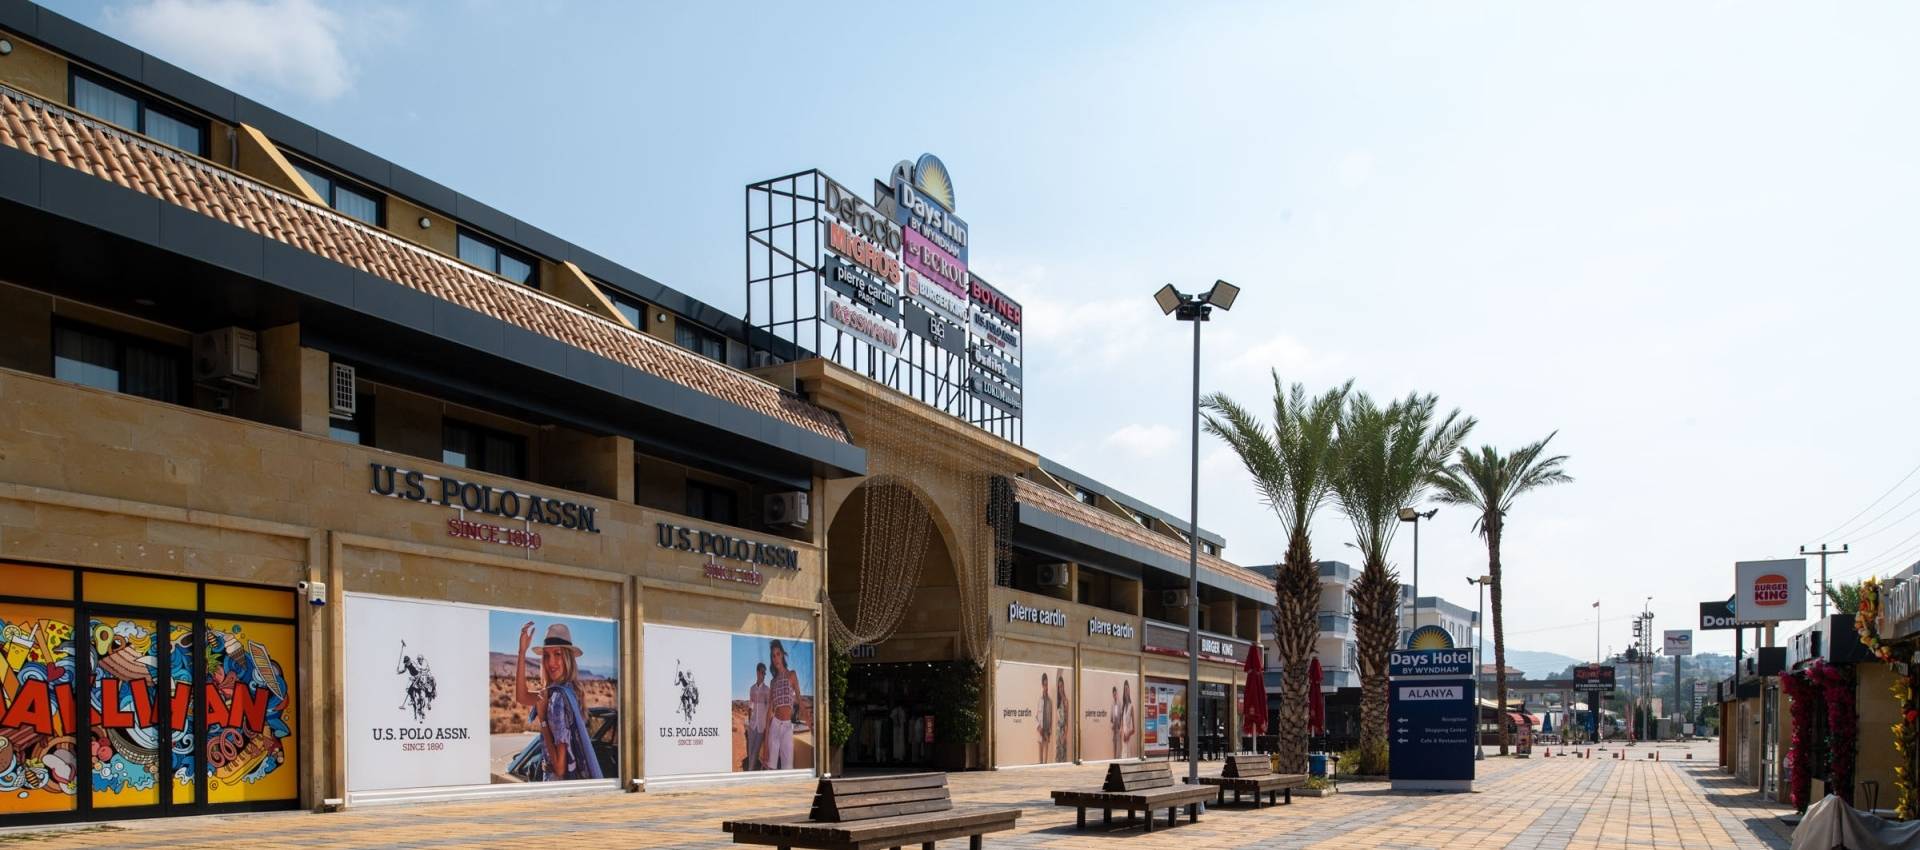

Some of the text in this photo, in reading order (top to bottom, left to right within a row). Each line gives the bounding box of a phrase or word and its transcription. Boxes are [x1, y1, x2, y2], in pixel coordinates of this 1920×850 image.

[903, 183, 967, 246] Days Inn
[911, 217, 922, 233] BY
[922, 224, 960, 258] WYNDHAM
[838, 266, 895, 307] pierre cardin
[858, 290, 876, 306] PARIS
[971, 280, 1020, 325] BOYNER
[831, 300, 898, 349] ROSSMANN
[369, 463, 600, 533] U.S. POLO ASSN.
[447, 518, 500, 543] SINCE
[656, 522, 802, 572] U.S. POLO ASSN.
[1754, 583, 1788, 600] BURGER KING
[1009, 601, 1067, 628] pierre cardin
[1089, 617, 1134, 639] pierre cardin
[1201, 638, 1233, 657] BURGER KING
[1390, 652, 1472, 667] Days Hotel
[1415, 666, 1459, 674] WYNDHAM
[1408, 689, 1454, 698] ALANYA
[1003, 707, 1017, 719] pierre
[372, 727, 471, 740] U.S. POLO ASSN.
[659, 727, 720, 738] U.S. POLO ASSN.
[402, 742, 444, 751] SINCE 1890
